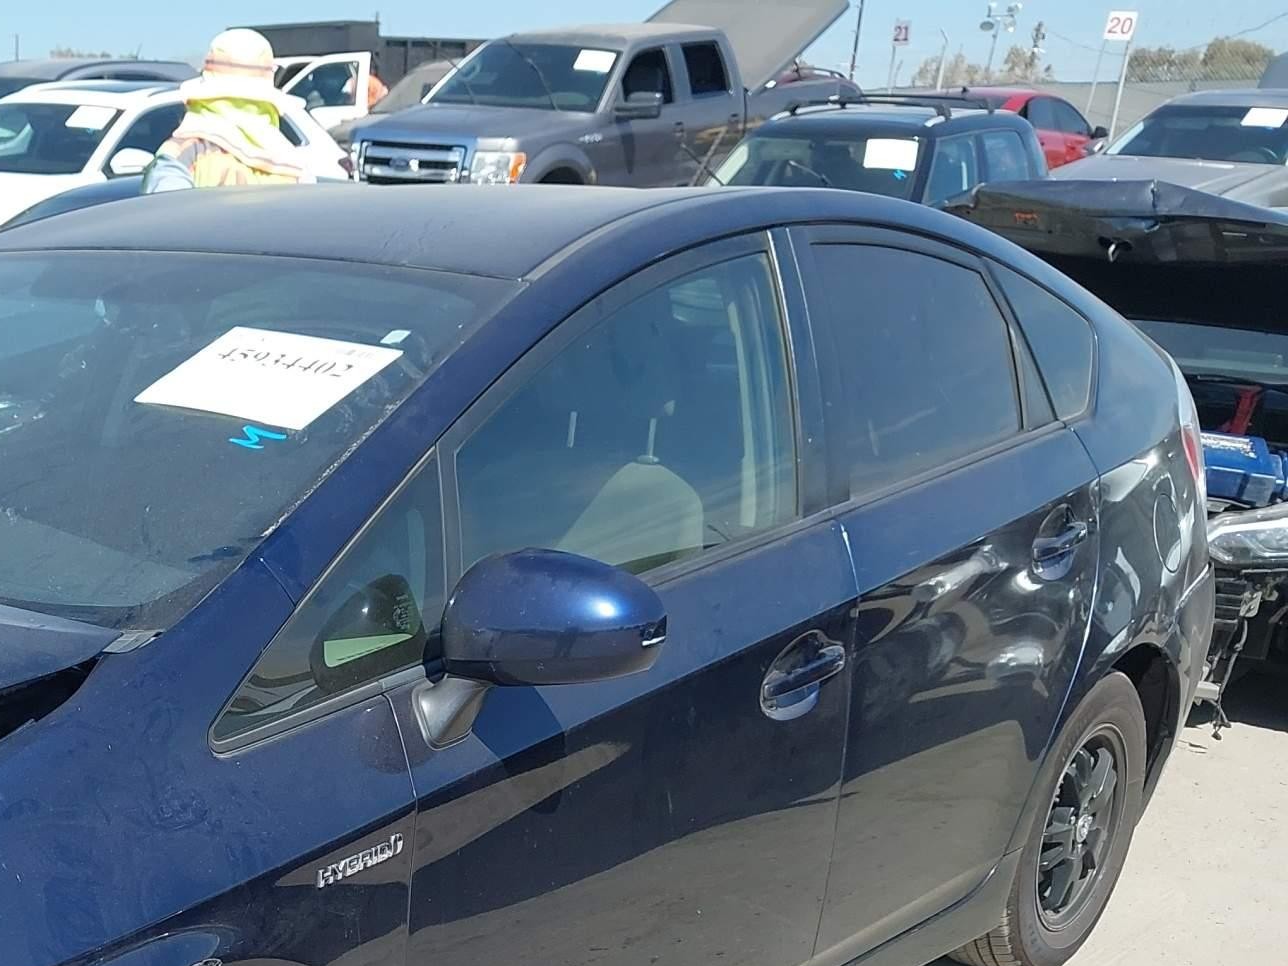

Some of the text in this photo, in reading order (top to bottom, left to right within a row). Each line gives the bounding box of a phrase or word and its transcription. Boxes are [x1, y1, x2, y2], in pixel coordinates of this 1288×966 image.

[892, 25, 910, 43] 21
[1107, 16, 1134, 36] 20
[316, 832, 404, 889] HYBRID
